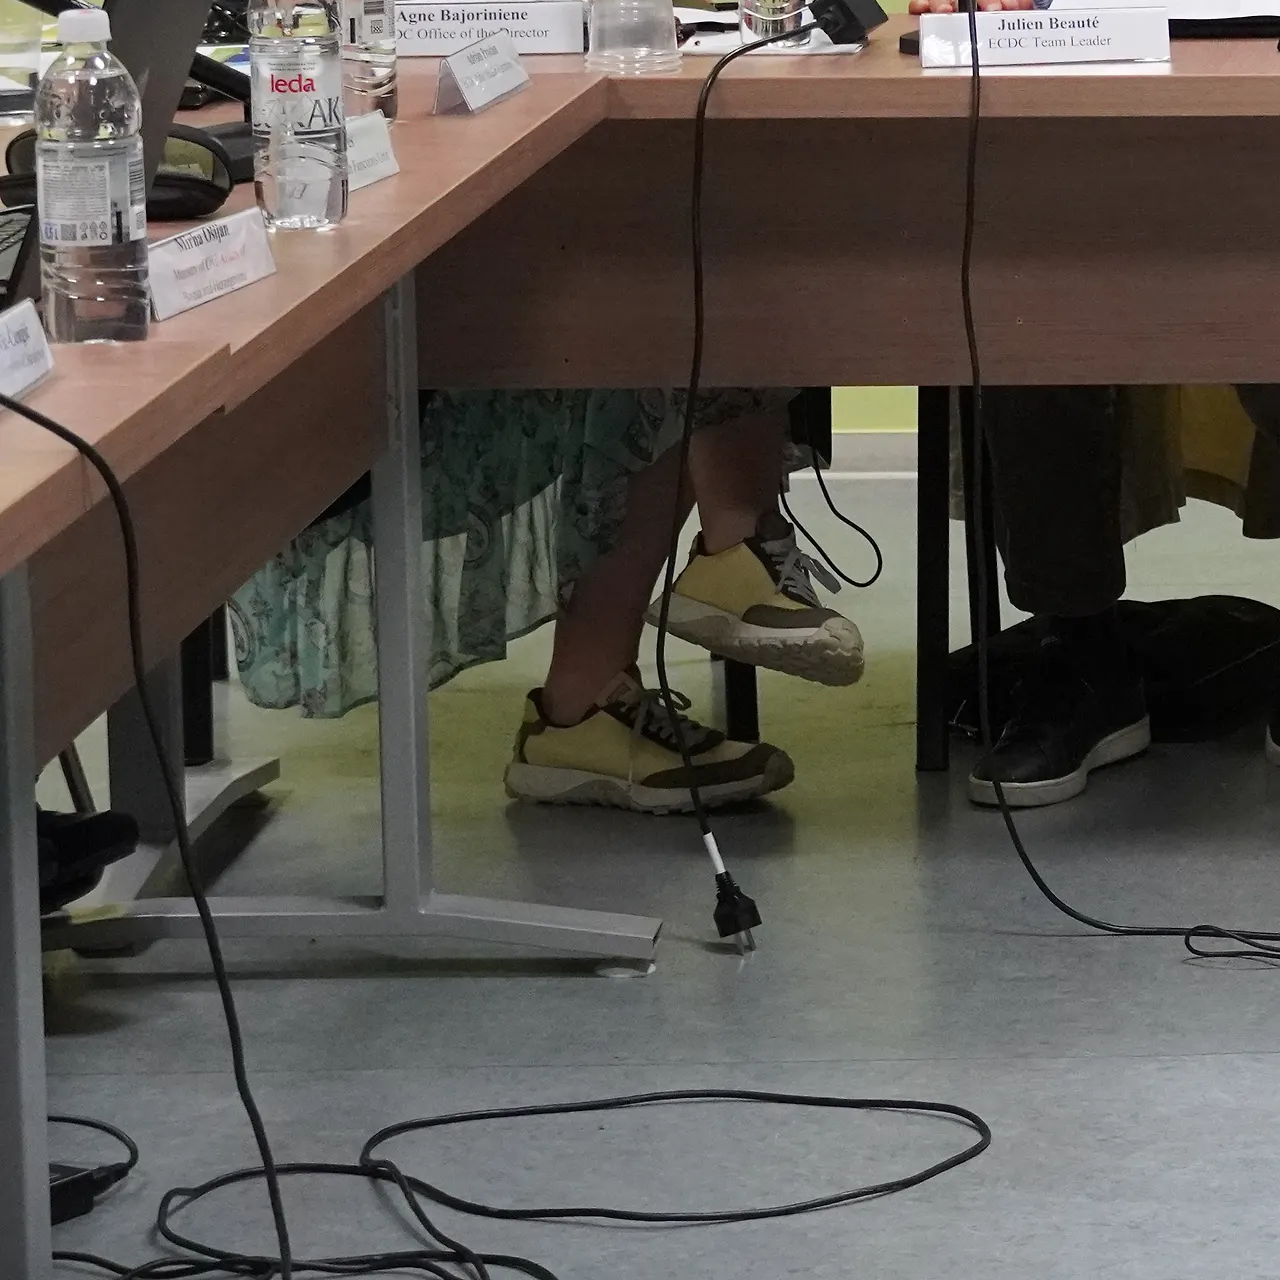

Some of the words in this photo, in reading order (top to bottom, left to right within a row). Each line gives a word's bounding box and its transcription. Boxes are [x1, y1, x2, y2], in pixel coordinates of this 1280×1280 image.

[397, 10, 435, 25] Agne
[441, 9, 528, 24] Bajoriniene
[998, 18, 1043, 31] Julien
[1049, 16, 1100, 30] Beauté
[417, 28, 456, 39] Office
[460, 27, 475, 39] of
[988, 37, 1028, 49] ECDC
[1033, 36, 1066, 48] Team
[1070, 35, 1112, 47] Leader
[270, 73, 316, 94] leda
